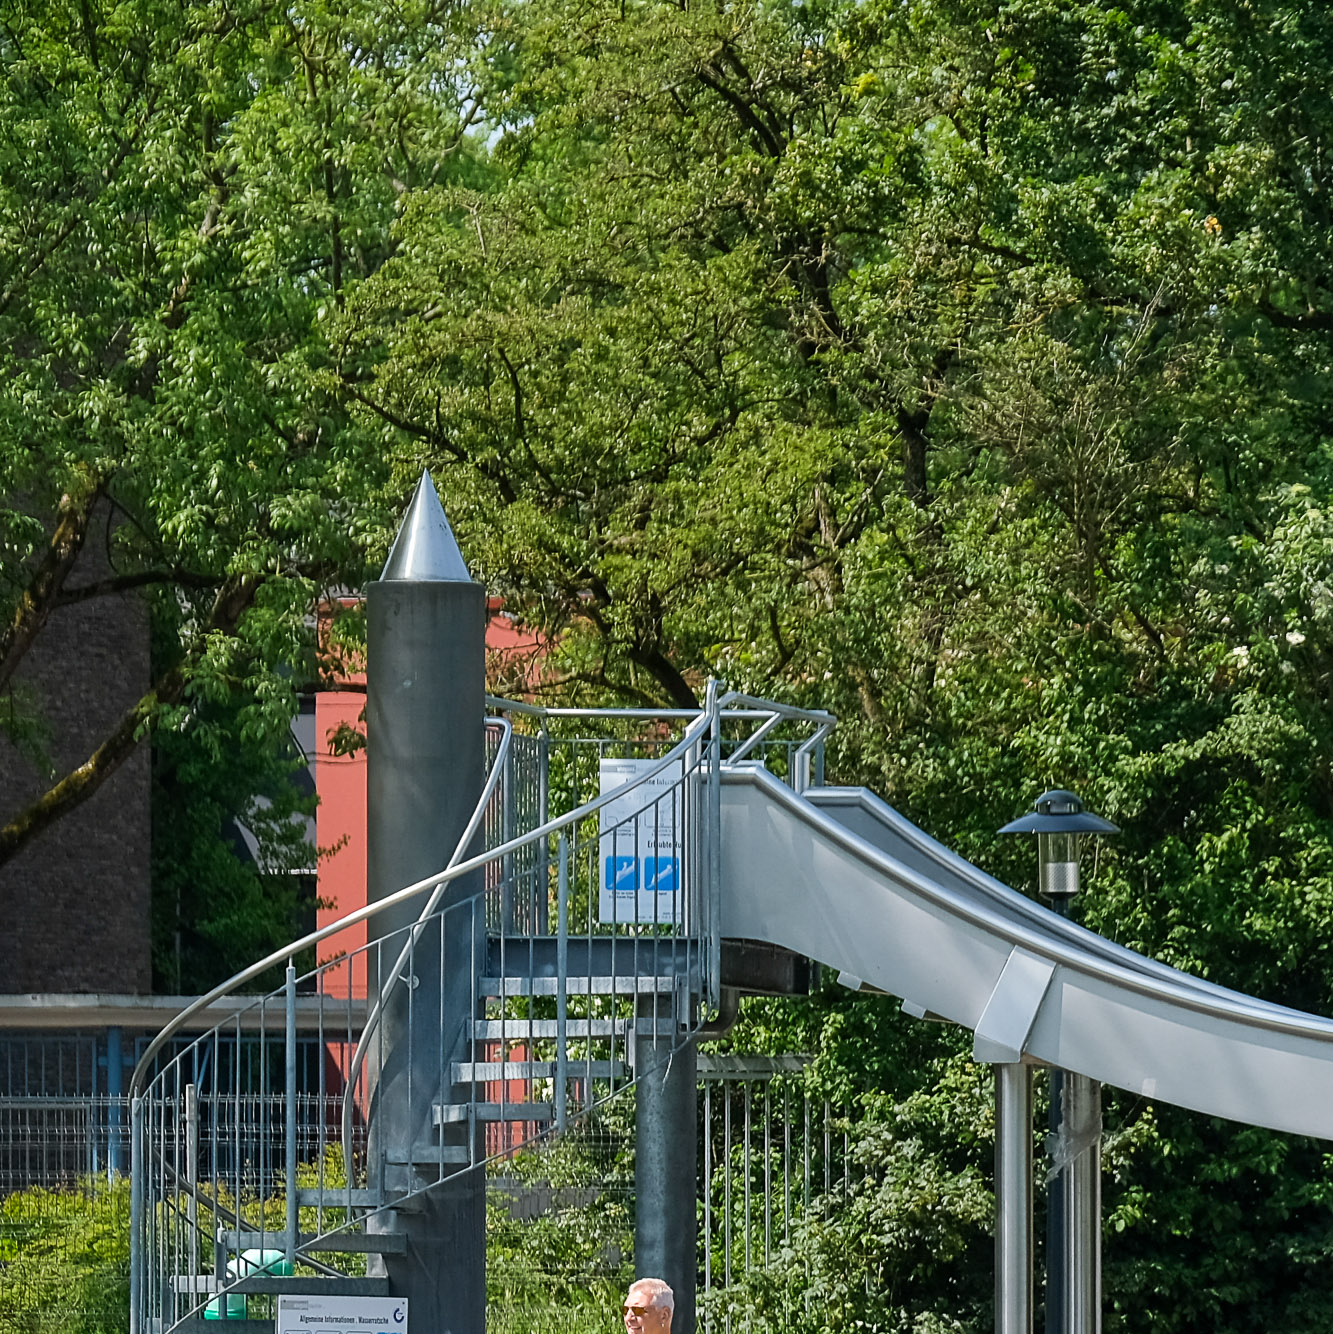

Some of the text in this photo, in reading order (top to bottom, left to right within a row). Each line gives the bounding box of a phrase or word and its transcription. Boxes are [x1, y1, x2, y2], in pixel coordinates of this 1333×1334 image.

[647, 840, 672, 849] Erlubte
[299, 1314, 324, 1324] Allgemeine
[324, 1315, 355, 1324] Informationen
[358, 1316, 389, 1325] Wasserrutsche
